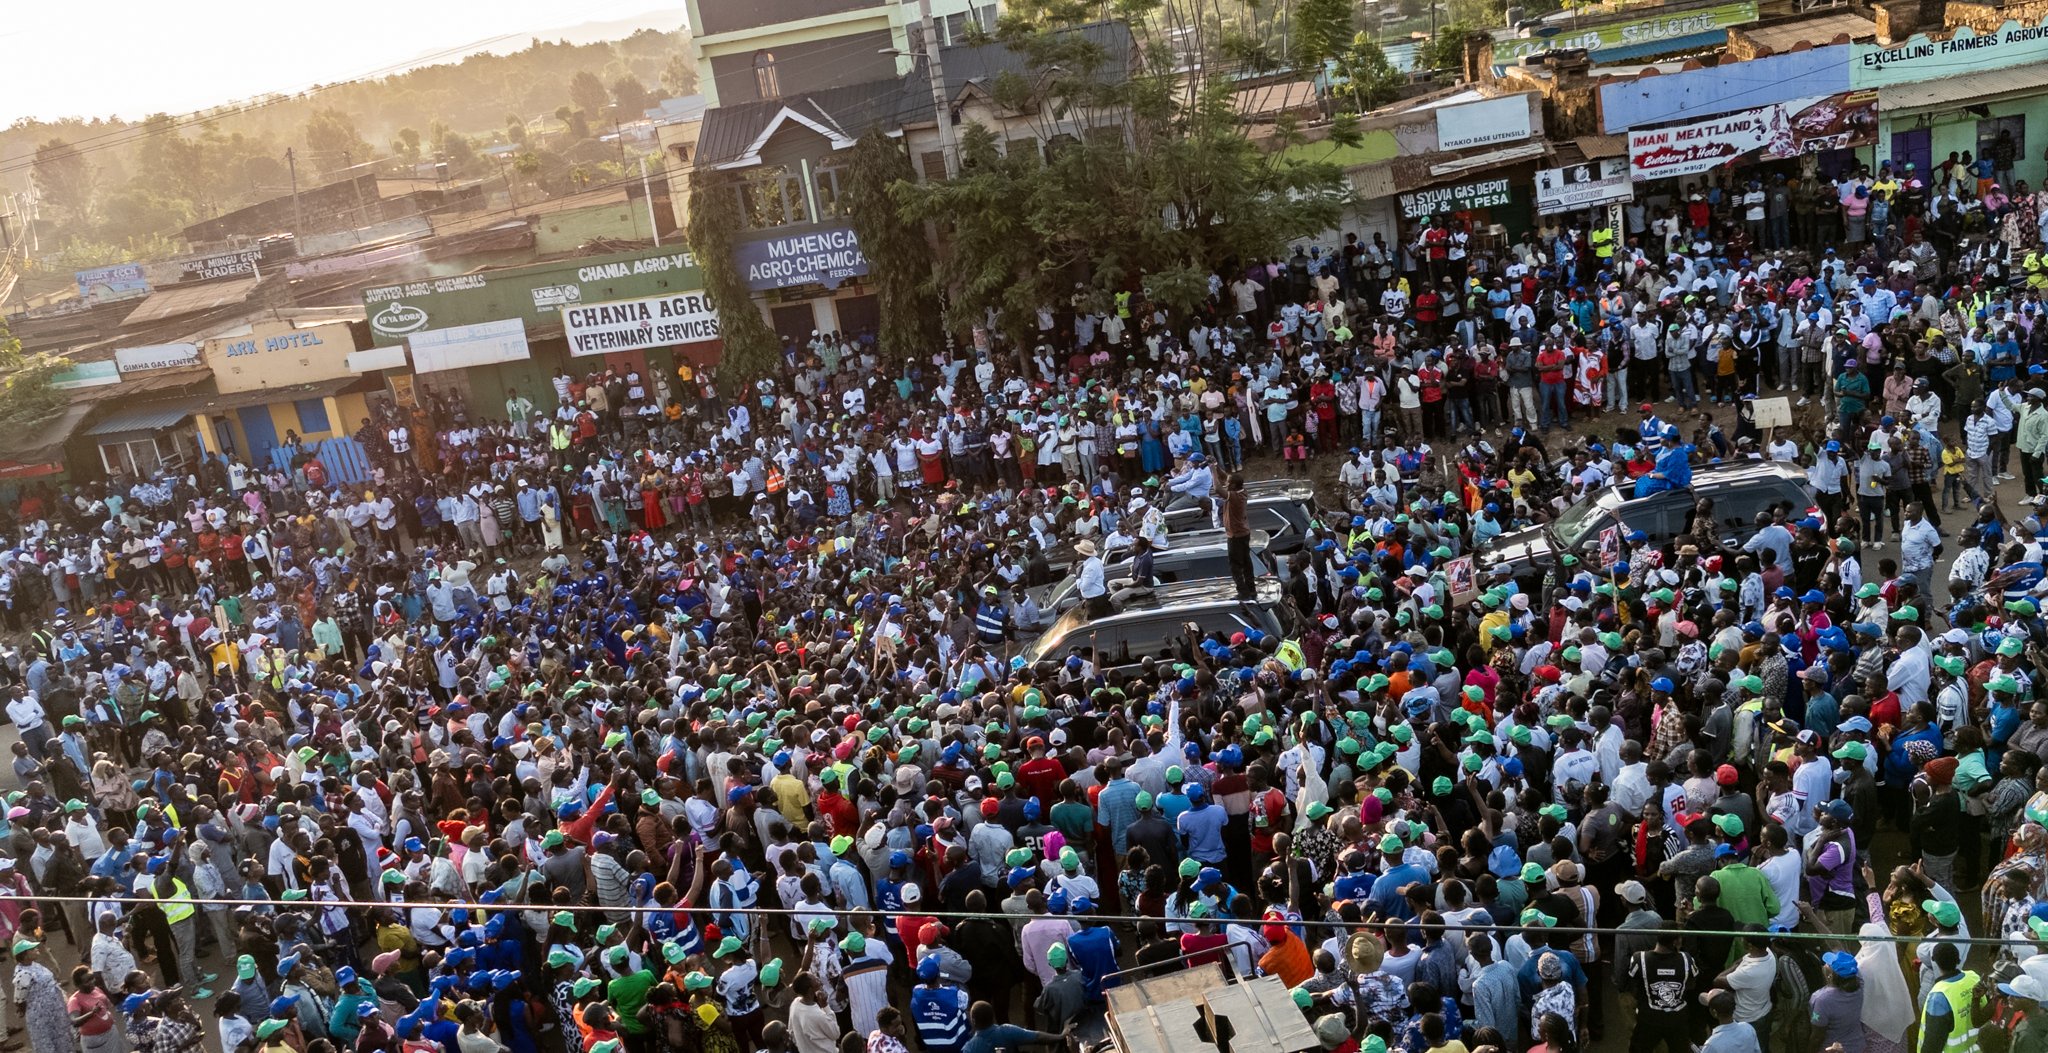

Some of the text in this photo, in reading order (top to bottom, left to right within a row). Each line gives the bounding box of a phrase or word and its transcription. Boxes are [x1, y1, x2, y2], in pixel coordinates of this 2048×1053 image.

[1864, 44, 1934, 66] EXCELLING
[1941, 35, 1998, 54] FARMERS
[1444, 138, 1471, 147] NYAKIO
[1492, 129, 1526, 140] UTENSILS
[1633, 120, 1751, 148] IMANI MEATLAND
[1400, 179, 1509, 207] WA SYLVIA GAS DEPOT
[1404, 203, 1436, 218] SHOP
[1440, 201, 1451, 212] &
[1475, 193, 1509, 208] PESA
[1564, 189, 1603, 203] COMPANY
[767, 230, 858, 258] MUHENGA
[196, 262, 251, 280] TRADERS
[578, 252, 700, 283] CHANIA AGRO-VE
[777, 277, 784, 286] &
[788, 273, 819, 285] ANIMAL
[366, 286, 405, 303] JUPITER
[1387, 298, 1403, 309] 34
[569, 302, 652, 328] CHANIA
[640, 320, 651, 328] &
[226, 331, 323, 357] ARK HOTEL
[574, 319, 719, 351] VETERINARY SERVICES
[151, 360, 167, 369] GAS
[168, 357, 196, 367] CENTRE
